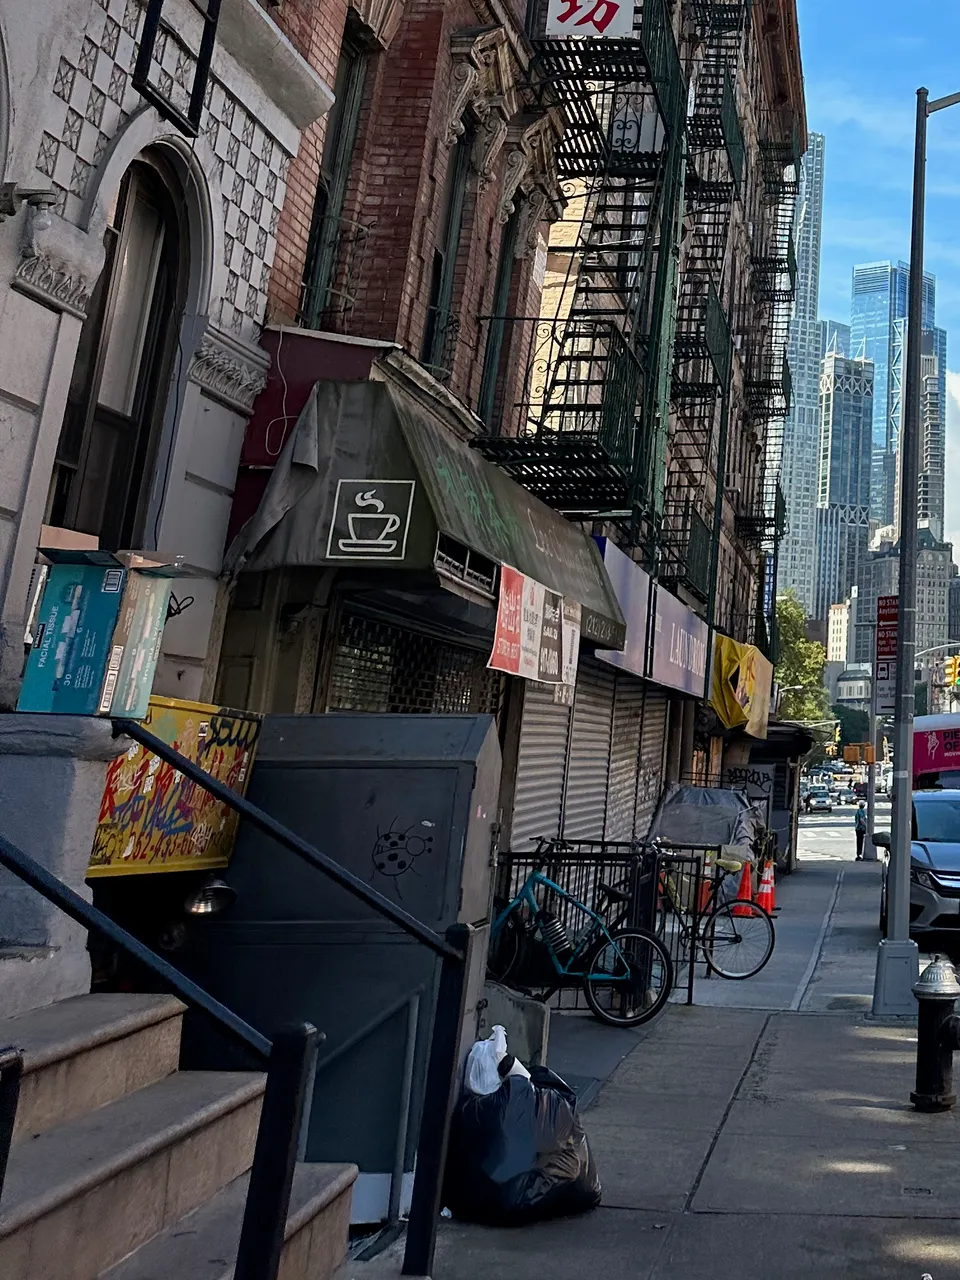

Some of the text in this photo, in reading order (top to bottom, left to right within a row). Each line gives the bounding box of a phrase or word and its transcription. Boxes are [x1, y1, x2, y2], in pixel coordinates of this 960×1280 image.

[38, 606, 59, 668] FACIAL TISSUE
[670, 623, 705, 677] LAUNDROM
[64, 674, 72, 686] 30
[944, 741, 960, 751] OF
